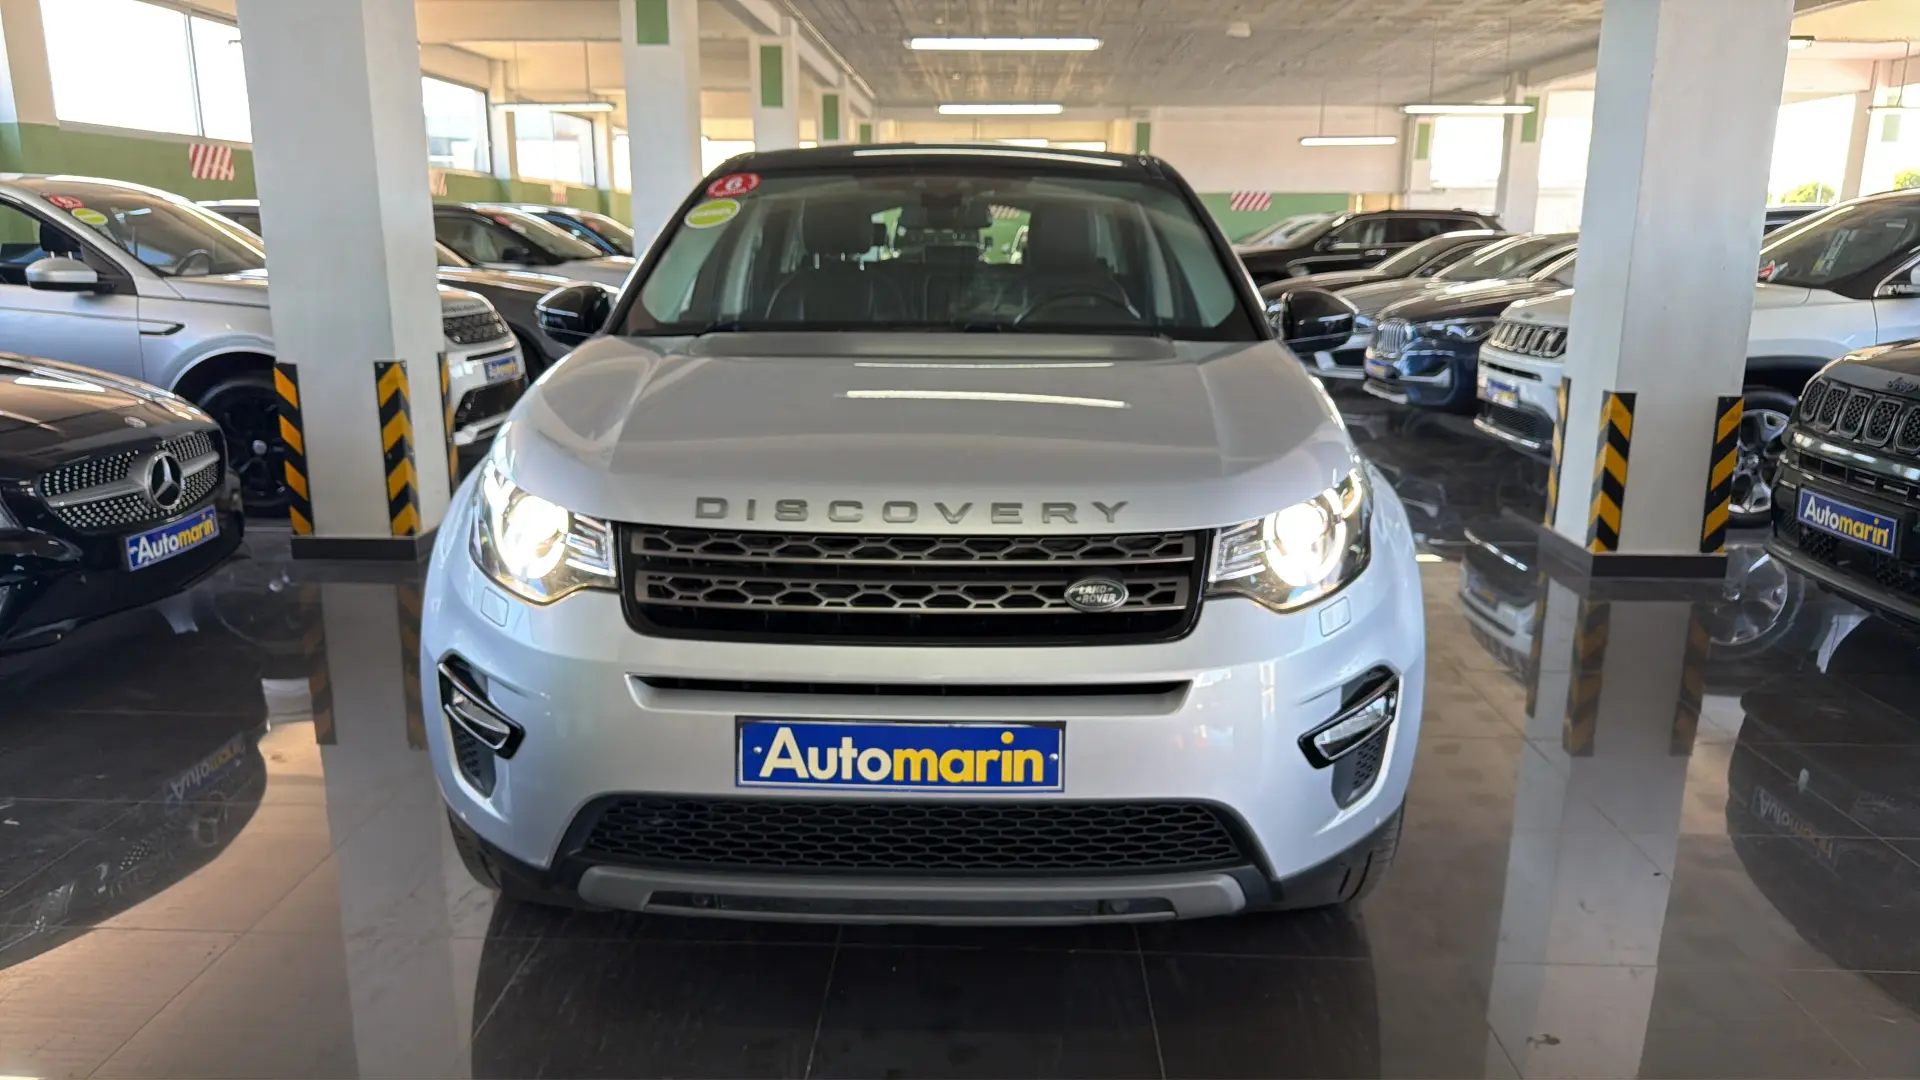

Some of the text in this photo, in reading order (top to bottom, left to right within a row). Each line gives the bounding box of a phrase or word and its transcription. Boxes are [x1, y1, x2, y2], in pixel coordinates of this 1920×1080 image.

[695, 496, 1129, 525] DISCOVERY
[1803, 495, 1889, 548] Automarin
[137, 513, 215, 564] Automarin
[758, 727, 1044, 783] Automarin
